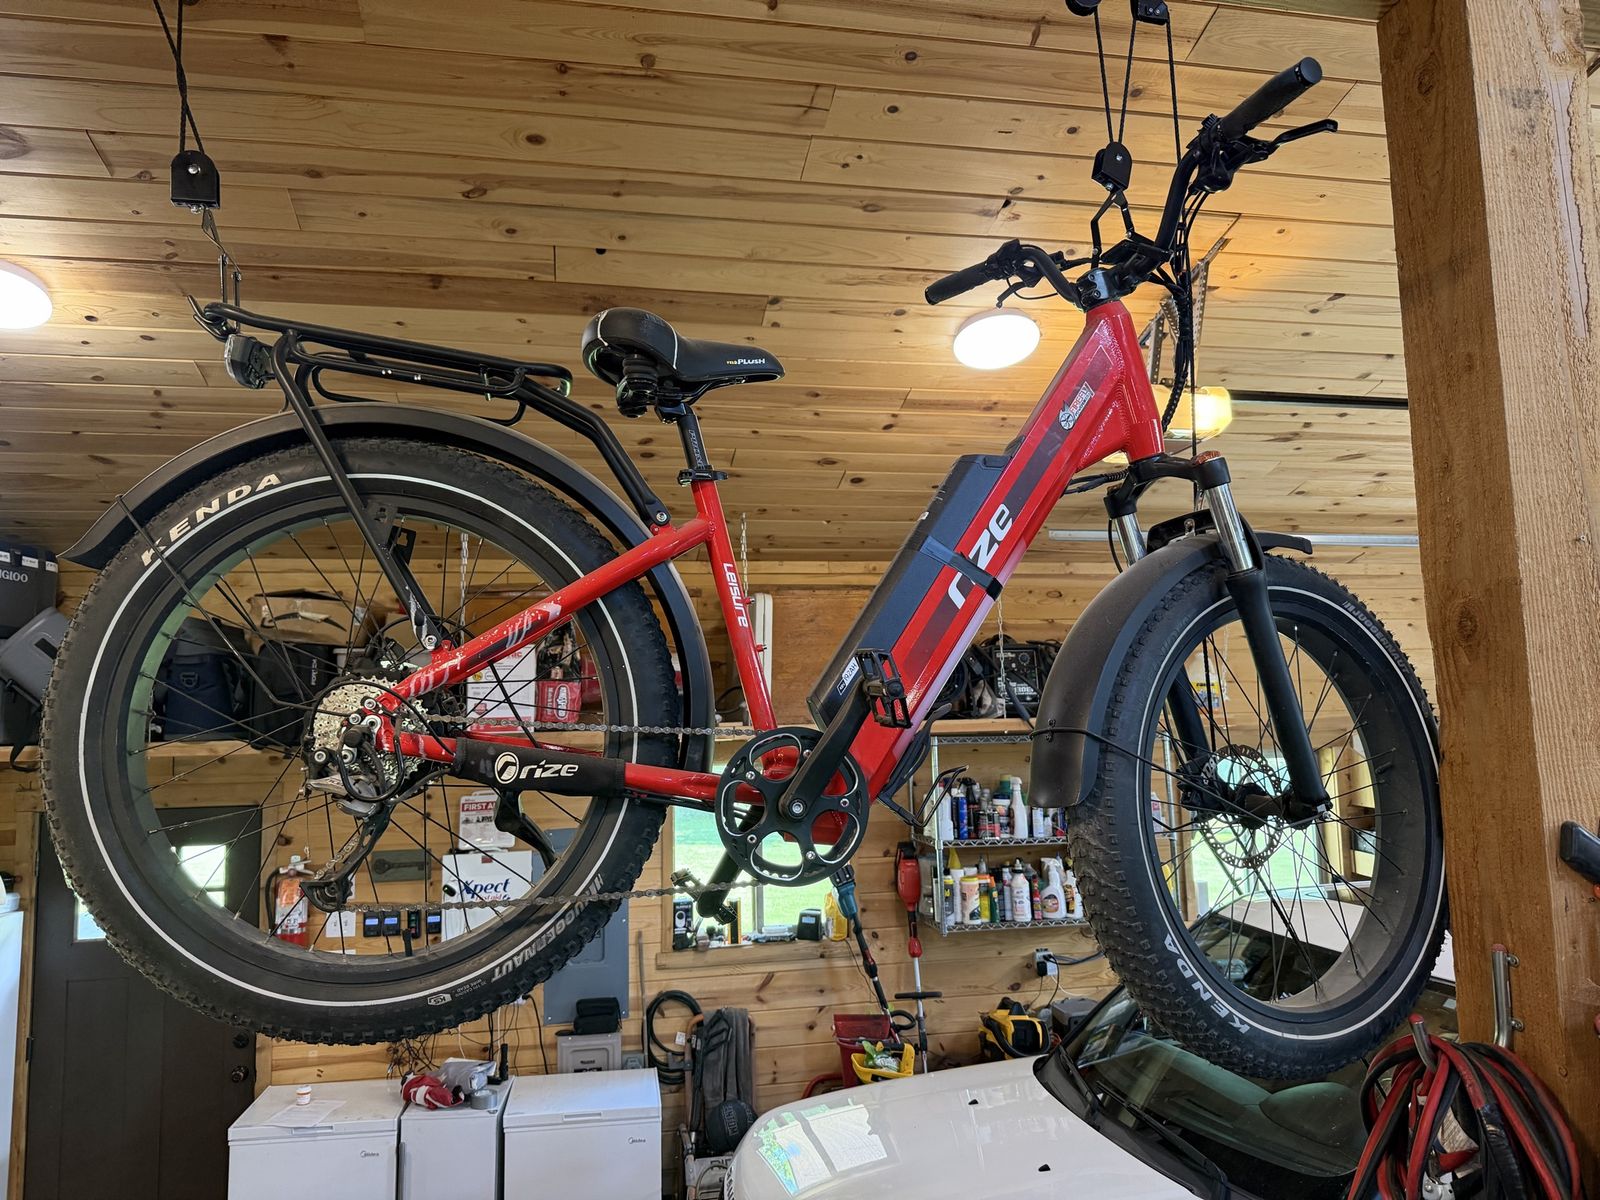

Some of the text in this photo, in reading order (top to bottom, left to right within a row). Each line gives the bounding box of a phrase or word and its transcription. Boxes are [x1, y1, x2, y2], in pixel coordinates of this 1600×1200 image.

[141, 473, 281, 567] KENDA
[947, 503, 1013, 610] rze
[463, 801, 496, 812] FIRST AI
[519, 759, 579, 779] rize
[1164, 932, 1251, 1034] KENDA
